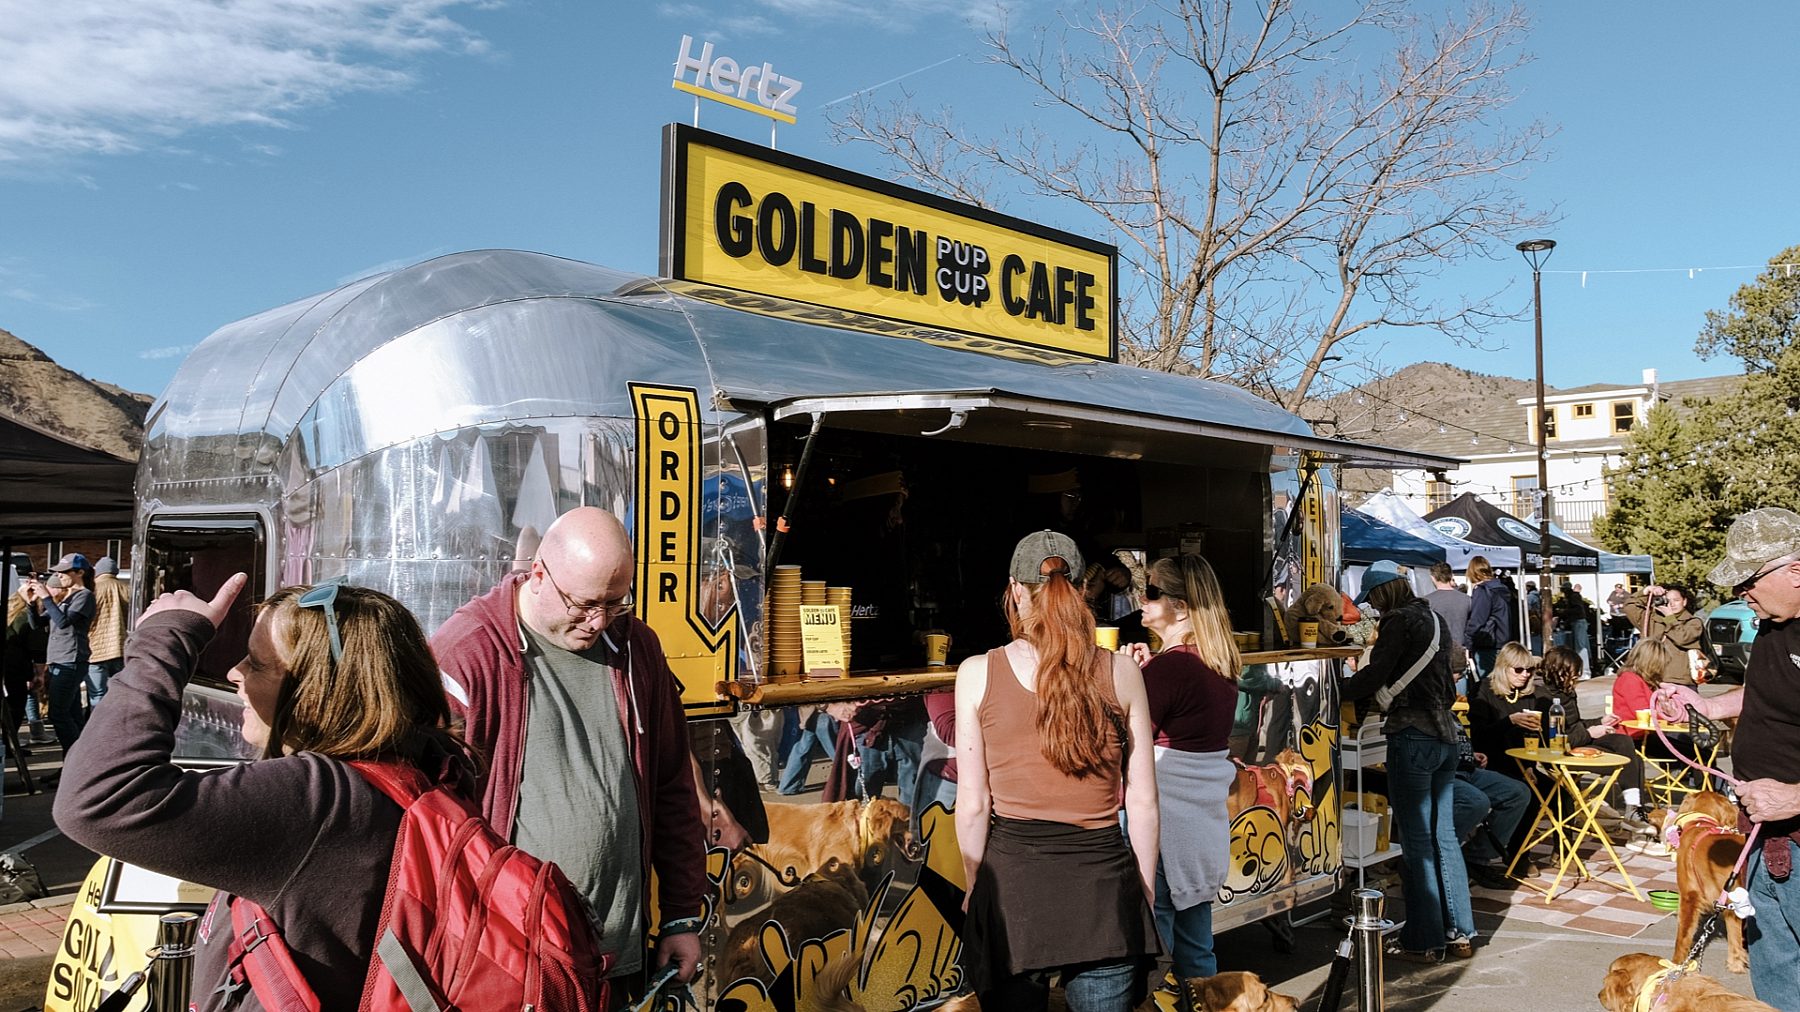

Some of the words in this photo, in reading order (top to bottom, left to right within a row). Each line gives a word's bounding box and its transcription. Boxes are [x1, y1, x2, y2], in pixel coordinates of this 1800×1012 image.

[674, 34, 802, 115] Hertz
[714, 181, 927, 296] GOLDEN
[937, 236, 989, 268] PUP
[937, 267, 989, 299] CUP
[1001, 254, 1096, 331] CAFE
[658, 411, 681, 603] ORDER
[804, 613, 837, 626] MENU
[851, 603, 880, 617] Hertz
[87, 881, 102, 908] He
